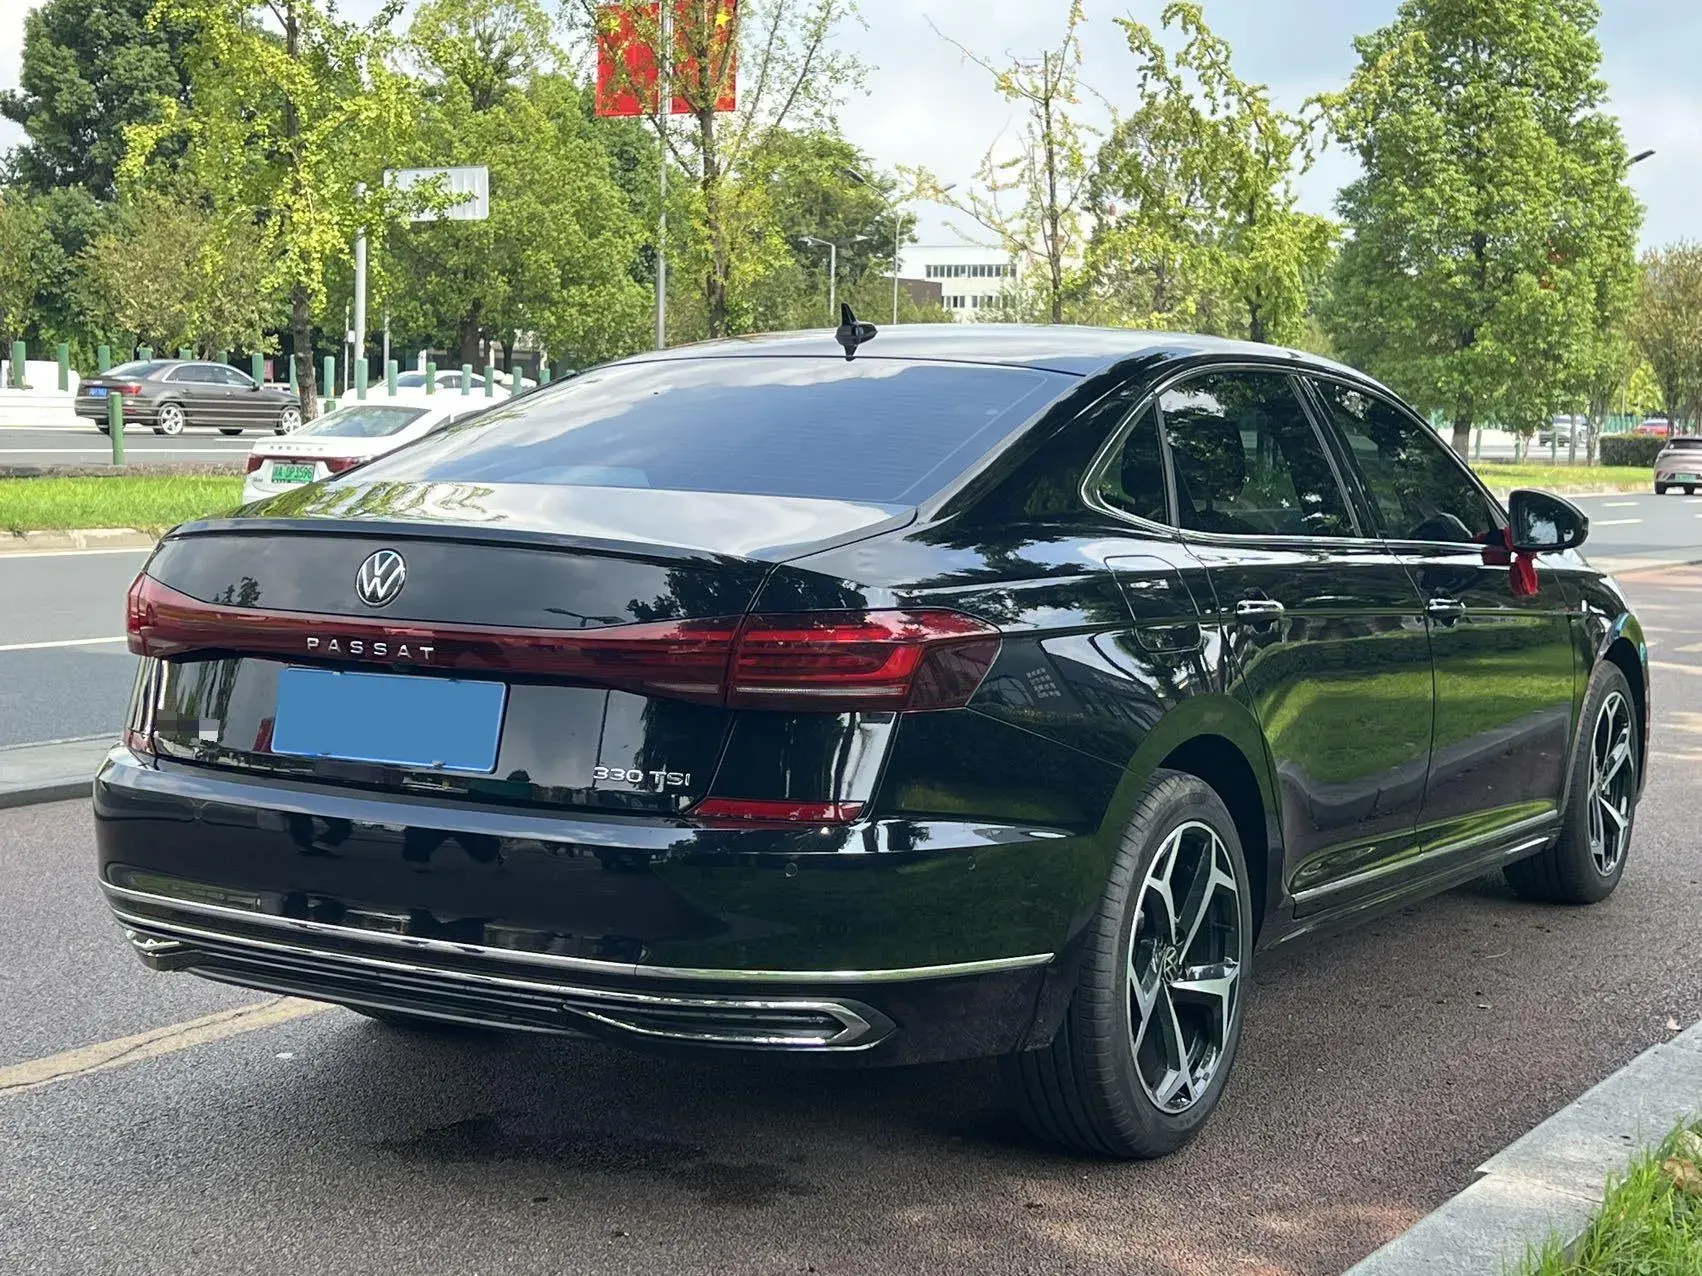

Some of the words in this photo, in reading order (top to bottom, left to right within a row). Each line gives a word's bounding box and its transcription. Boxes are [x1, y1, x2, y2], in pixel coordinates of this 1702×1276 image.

[306, 637, 434, 660] PASSAT
[593, 766, 644, 783] 330
[649, 770, 691, 786] TSI
